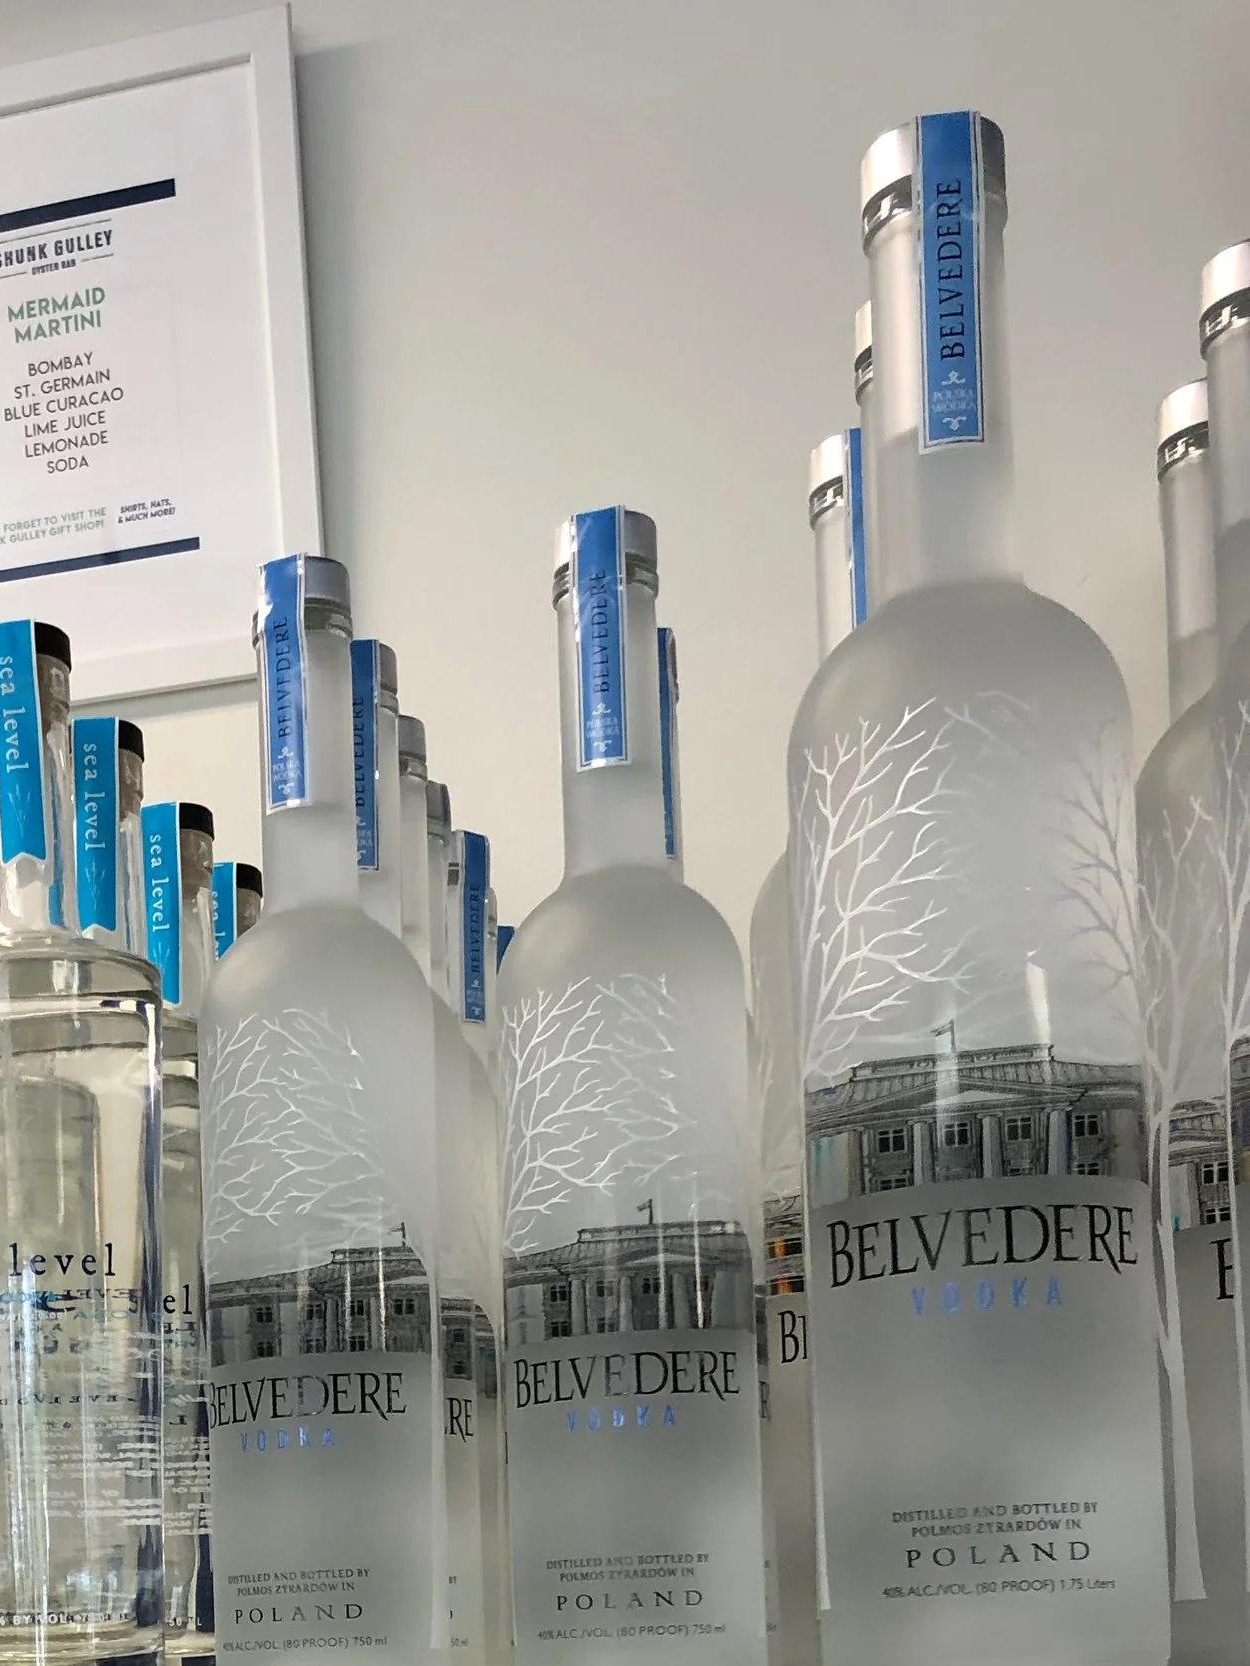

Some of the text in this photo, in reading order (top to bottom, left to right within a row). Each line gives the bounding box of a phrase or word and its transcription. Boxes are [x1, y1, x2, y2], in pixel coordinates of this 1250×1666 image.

[54, 229, 113, 257] GULLEY
[31, 262, 59, 275] OYSTER
[936, 179, 965, 362] BELVEDERE
[7, 287, 106, 322] MERMAID
[14, 310, 102, 343] MARTINI
[28, 352, 93, 376] BOMBAY
[14, 369, 111, 399] ST. GERMAIN
[4, 387, 124, 422] BLUE CURACAO
[24, 411, 106, 438] LIME JUICE
[24, 430, 109, 458] LEMONADE
[46, 456, 89, 474] SODA
[3, 519, 42, 533] FORGET
[44, 516, 58, 526] TO
[61, 512, 85, 523] VISIT
[88, 507, 106, 517] THE
[120, 498, 172, 514] SHIRTS, HATS,
[125, 512, 148, 523] MUCH
[150, 507, 176, 518] MORE!
[9, 529, 47, 543] GULLEY
[49, 525, 71, 536] GIFT
[75, 520, 105, 532] SHOP!
[591, 570, 610, 694] BELVEDERE
[276, 615, 293, 739] BELVEDERE
[3, 709, 29, 773] level
[83, 743, 106, 852] sea level
[149, 834, 170, 932] sea level
[8, 1242, 116, 1278] level
[826, 1204, 1139, 1288] BELVEDERE
[911, 1277, 1062, 1317] VODKA
[514, 1351, 740, 1409] BELVEDERE
[567, 1404, 676, 1432] VODKA
[892, 1502, 1080, 1524] DISTILLED BOTTLED
[906, 1540, 1090, 1568] POLAND
[273, 1571, 297, 1583] AND
[235, 1603, 363, 1624] POLAND
[556, 1589, 703, 1611] POLAND
[353, 1636, 372, 1647] 750
